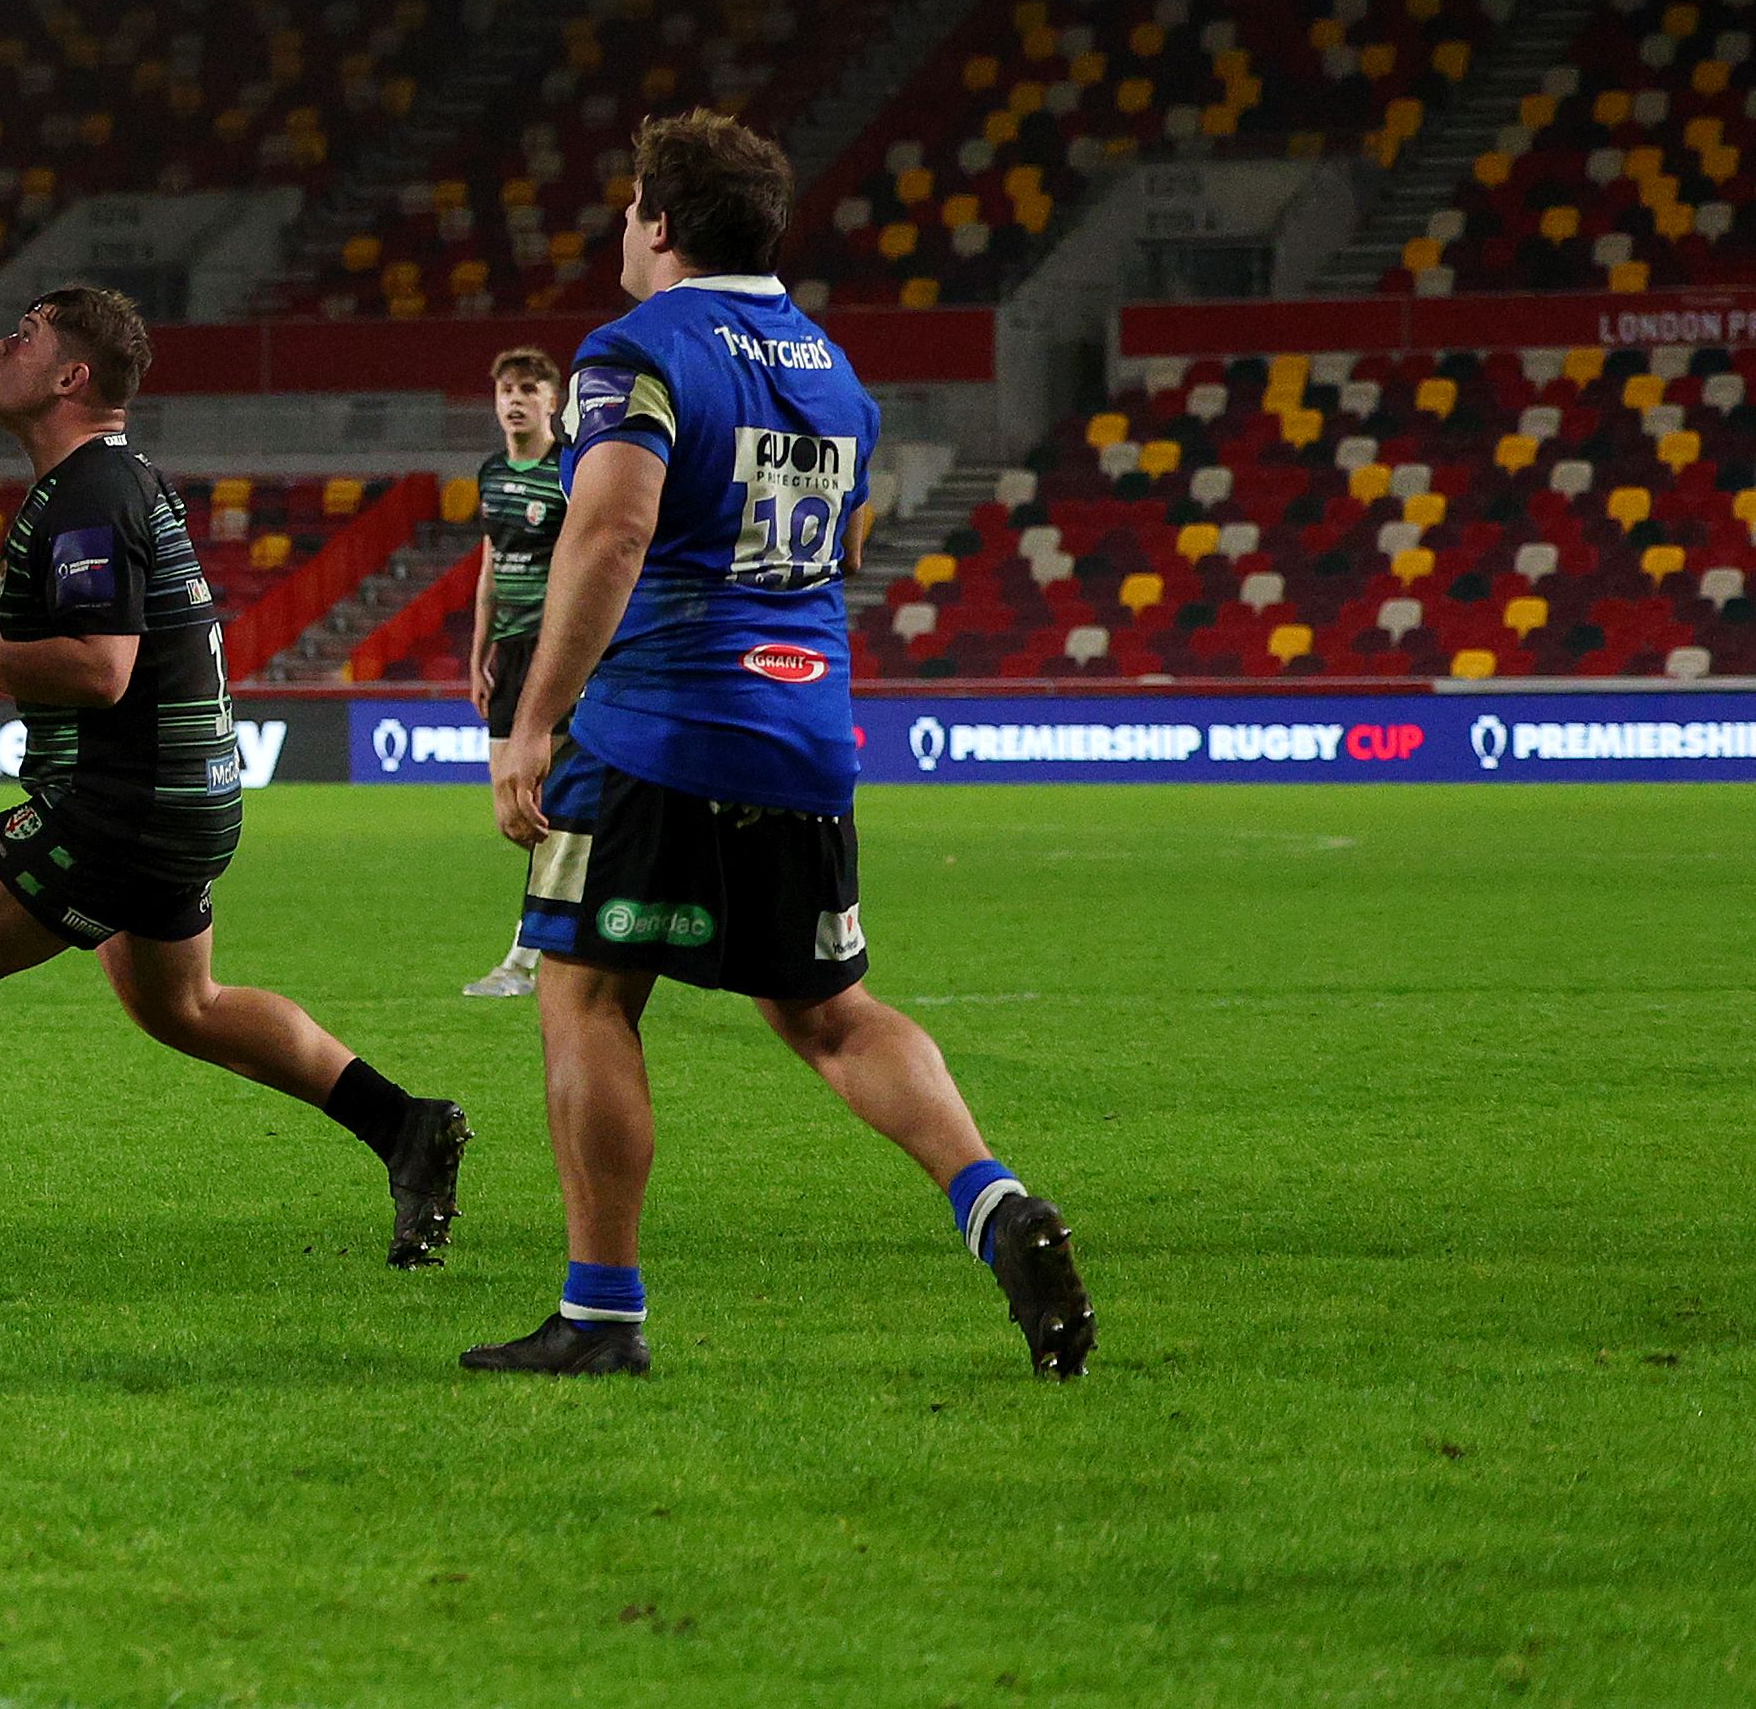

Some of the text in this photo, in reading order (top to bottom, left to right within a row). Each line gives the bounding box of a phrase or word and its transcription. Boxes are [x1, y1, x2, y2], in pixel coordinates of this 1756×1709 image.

[1599, 310, 1721, 342] LONDON
[714, 325, 833, 370] THATCHERS
[754, 655, 806, 670] GRANT
[949, 723, 1425, 761] PREMIERSHIP RUGBY CUP
